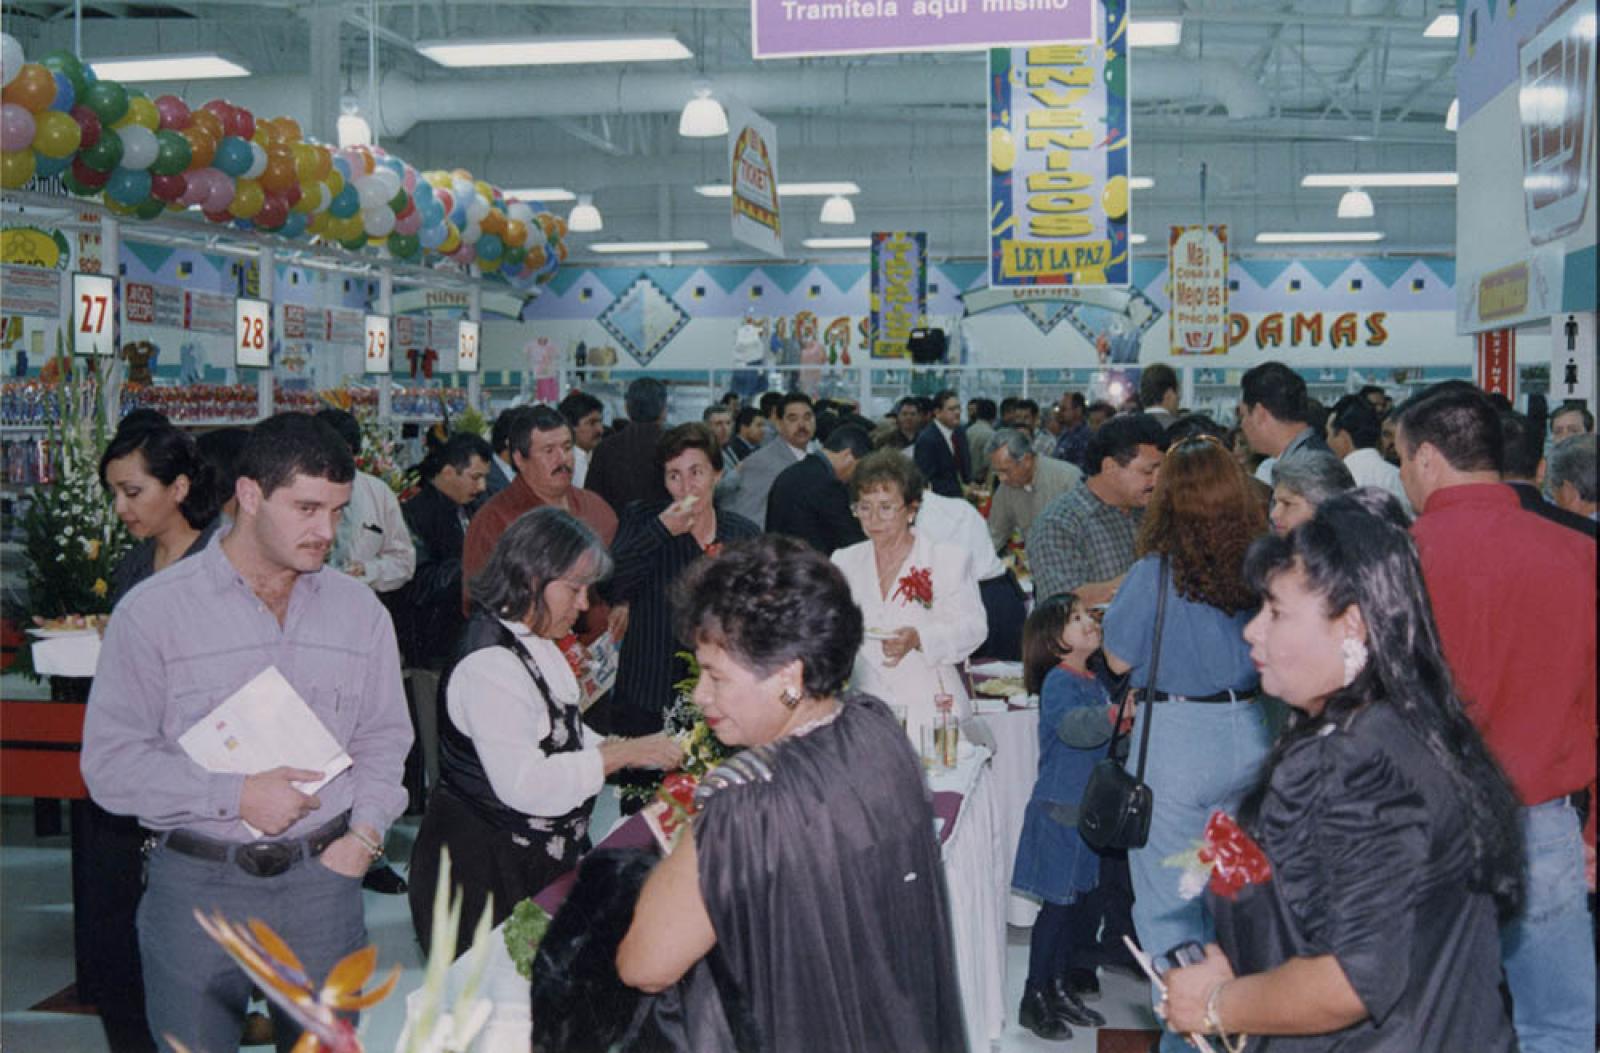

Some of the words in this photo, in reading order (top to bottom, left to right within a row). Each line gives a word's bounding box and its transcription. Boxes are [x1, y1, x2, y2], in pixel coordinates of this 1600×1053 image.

[1014, 249, 1044, 272] LEY
[1050, 247, 1069, 270] LA
[1075, 244, 1105, 268] PAZ
[80, 294, 107, 333] 27
[242, 316, 264, 349] 28
[368, 331, 385, 358] 29
[1229, 312, 1388, 350] DAMAS
